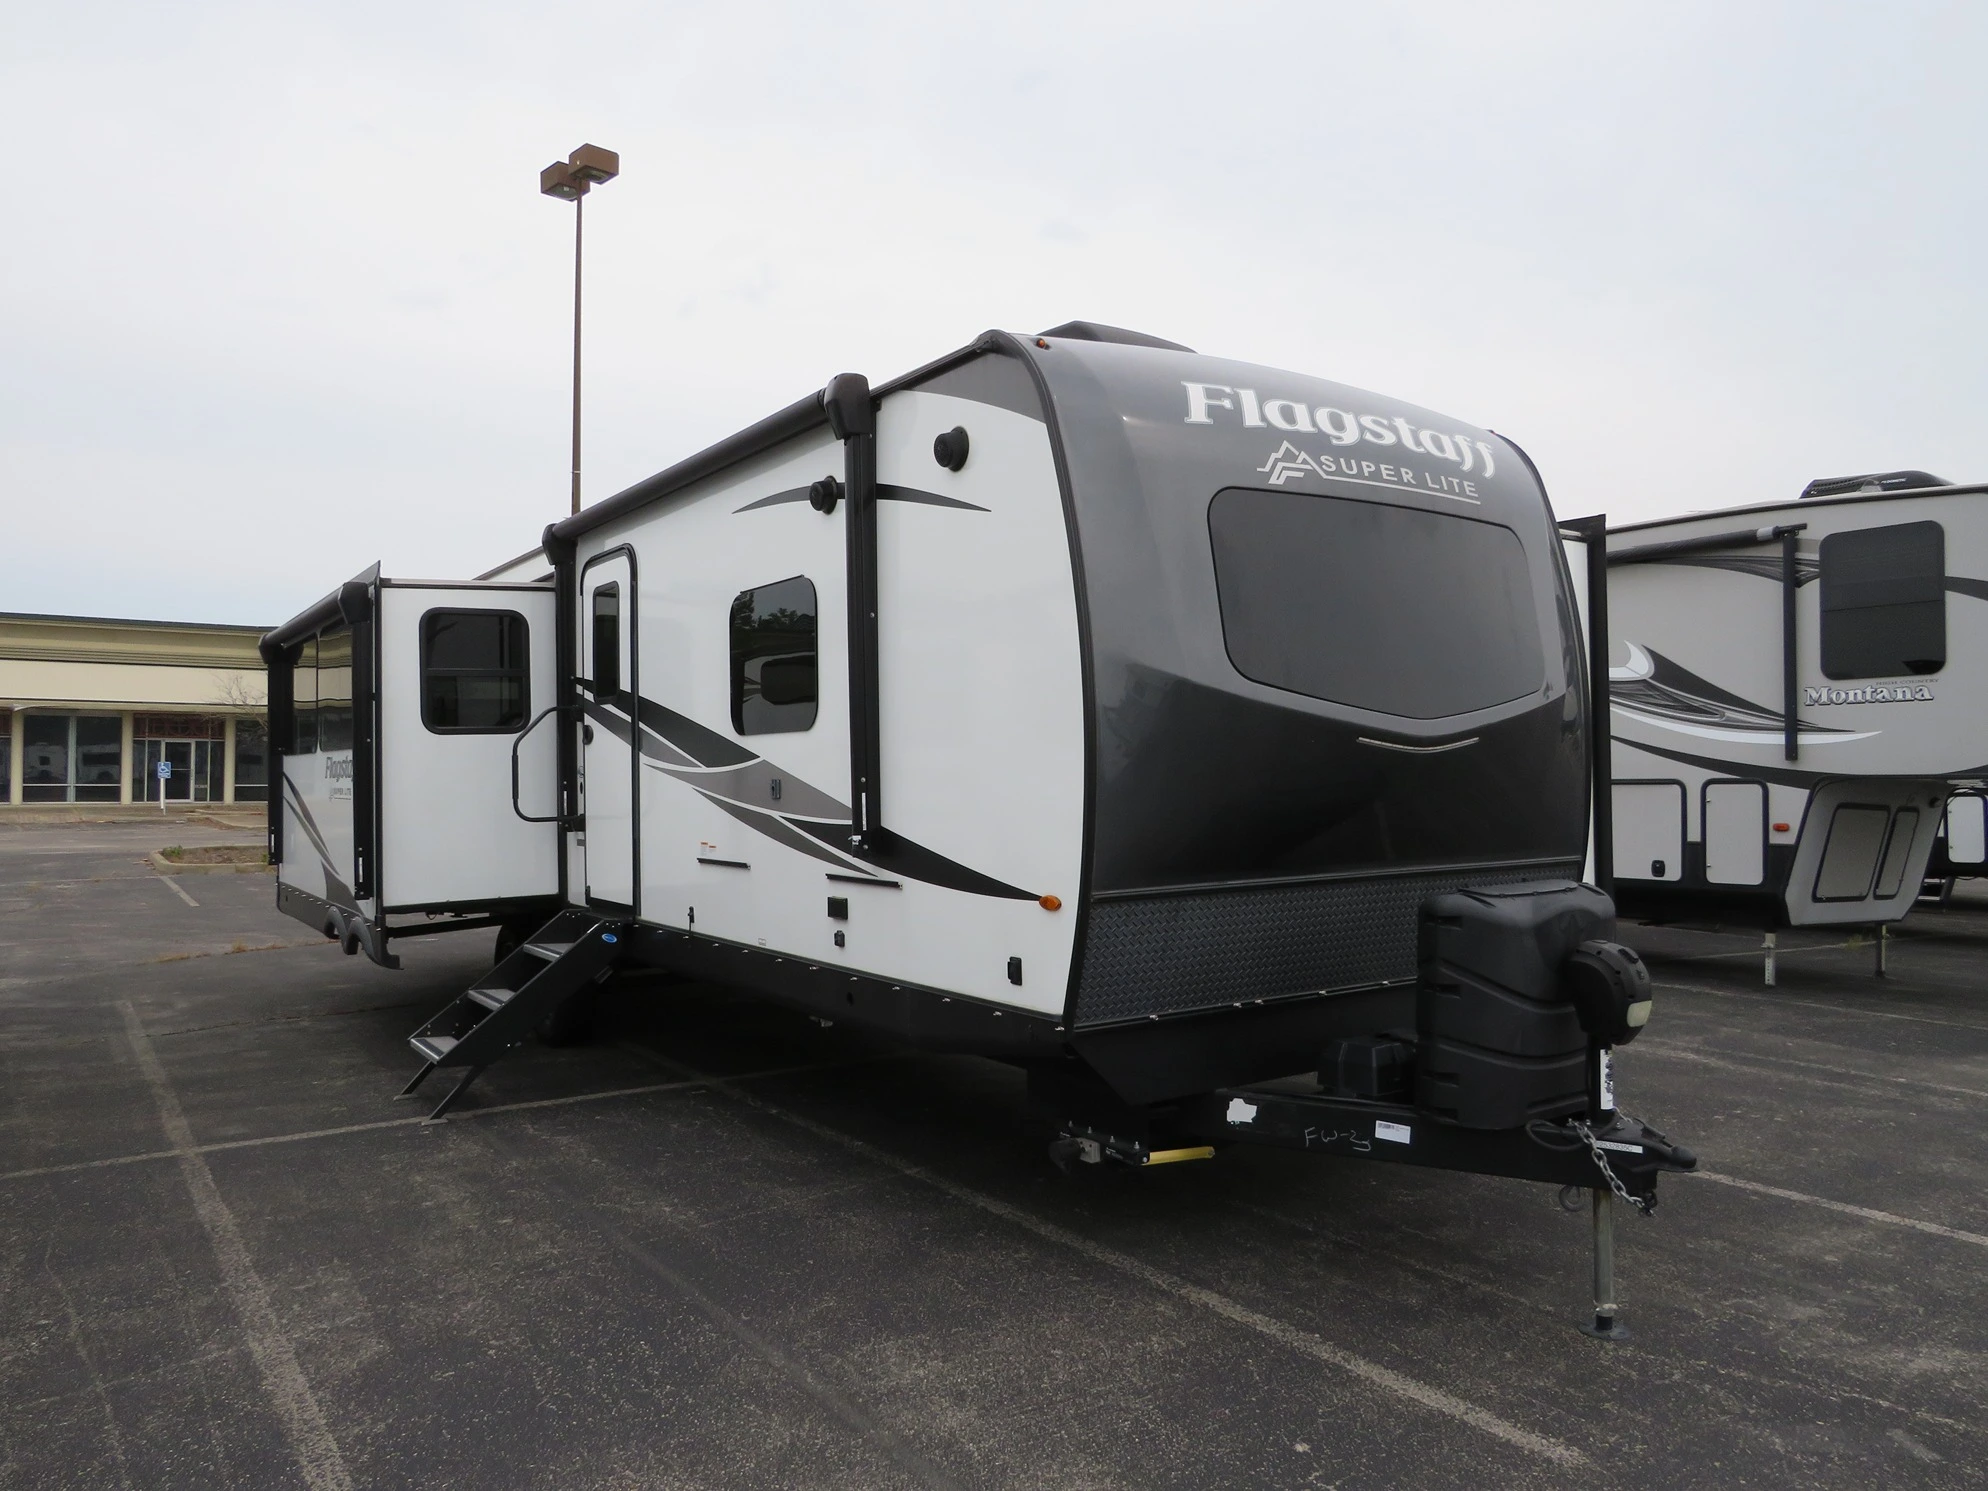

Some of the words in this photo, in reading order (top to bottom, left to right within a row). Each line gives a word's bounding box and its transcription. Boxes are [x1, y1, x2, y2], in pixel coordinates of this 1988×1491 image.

[1183, 381, 1495, 478] Flagstaff
[1320, 454, 1417, 484] SUPER
[1425, 472, 1479, 498] LITE
[1804, 685, 1933, 706] Montana
